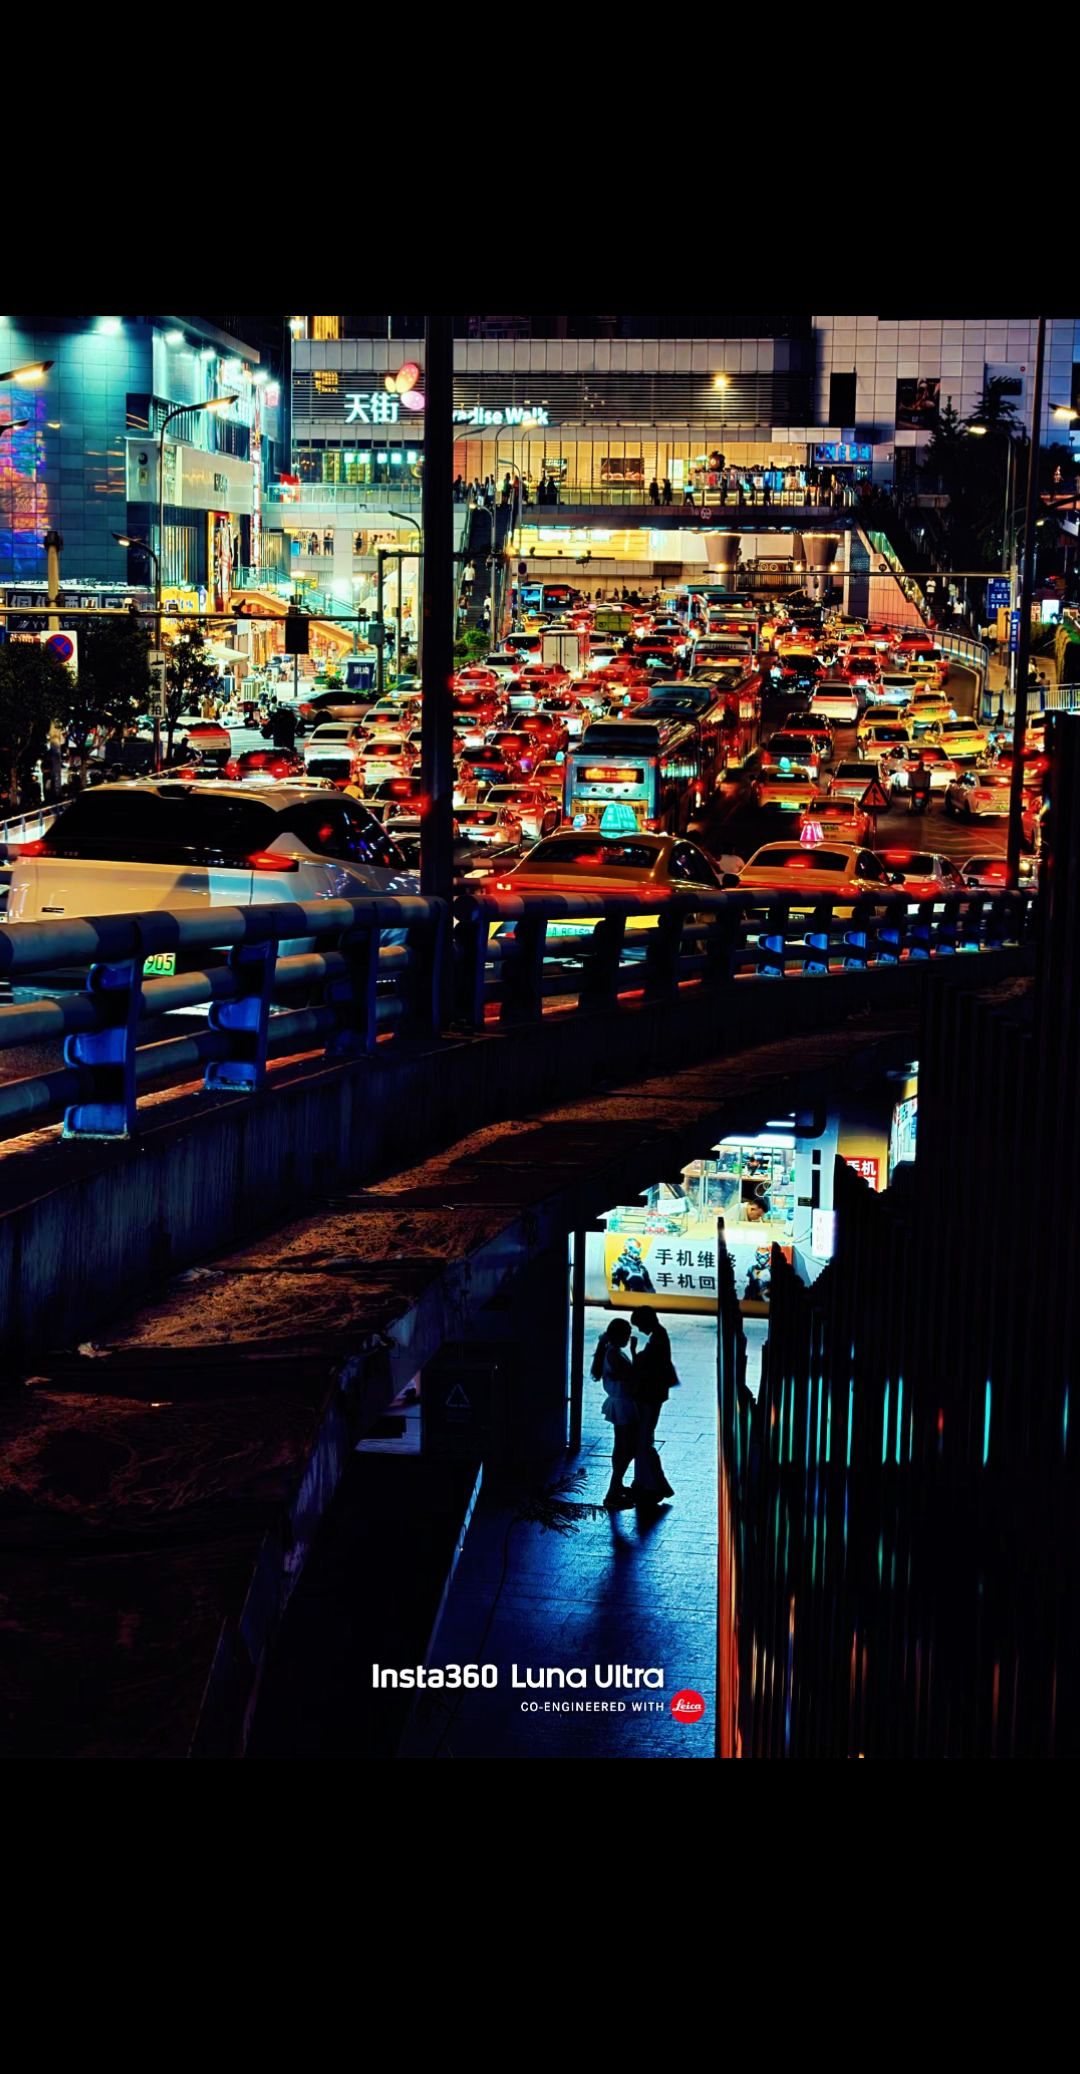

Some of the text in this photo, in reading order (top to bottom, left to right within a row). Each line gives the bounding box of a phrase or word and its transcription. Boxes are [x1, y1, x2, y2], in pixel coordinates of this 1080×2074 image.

[343, 392, 400, 423] 天街
[505, 407, 548, 425] Walk
[656, 1272, 717, 1290] 手机回
